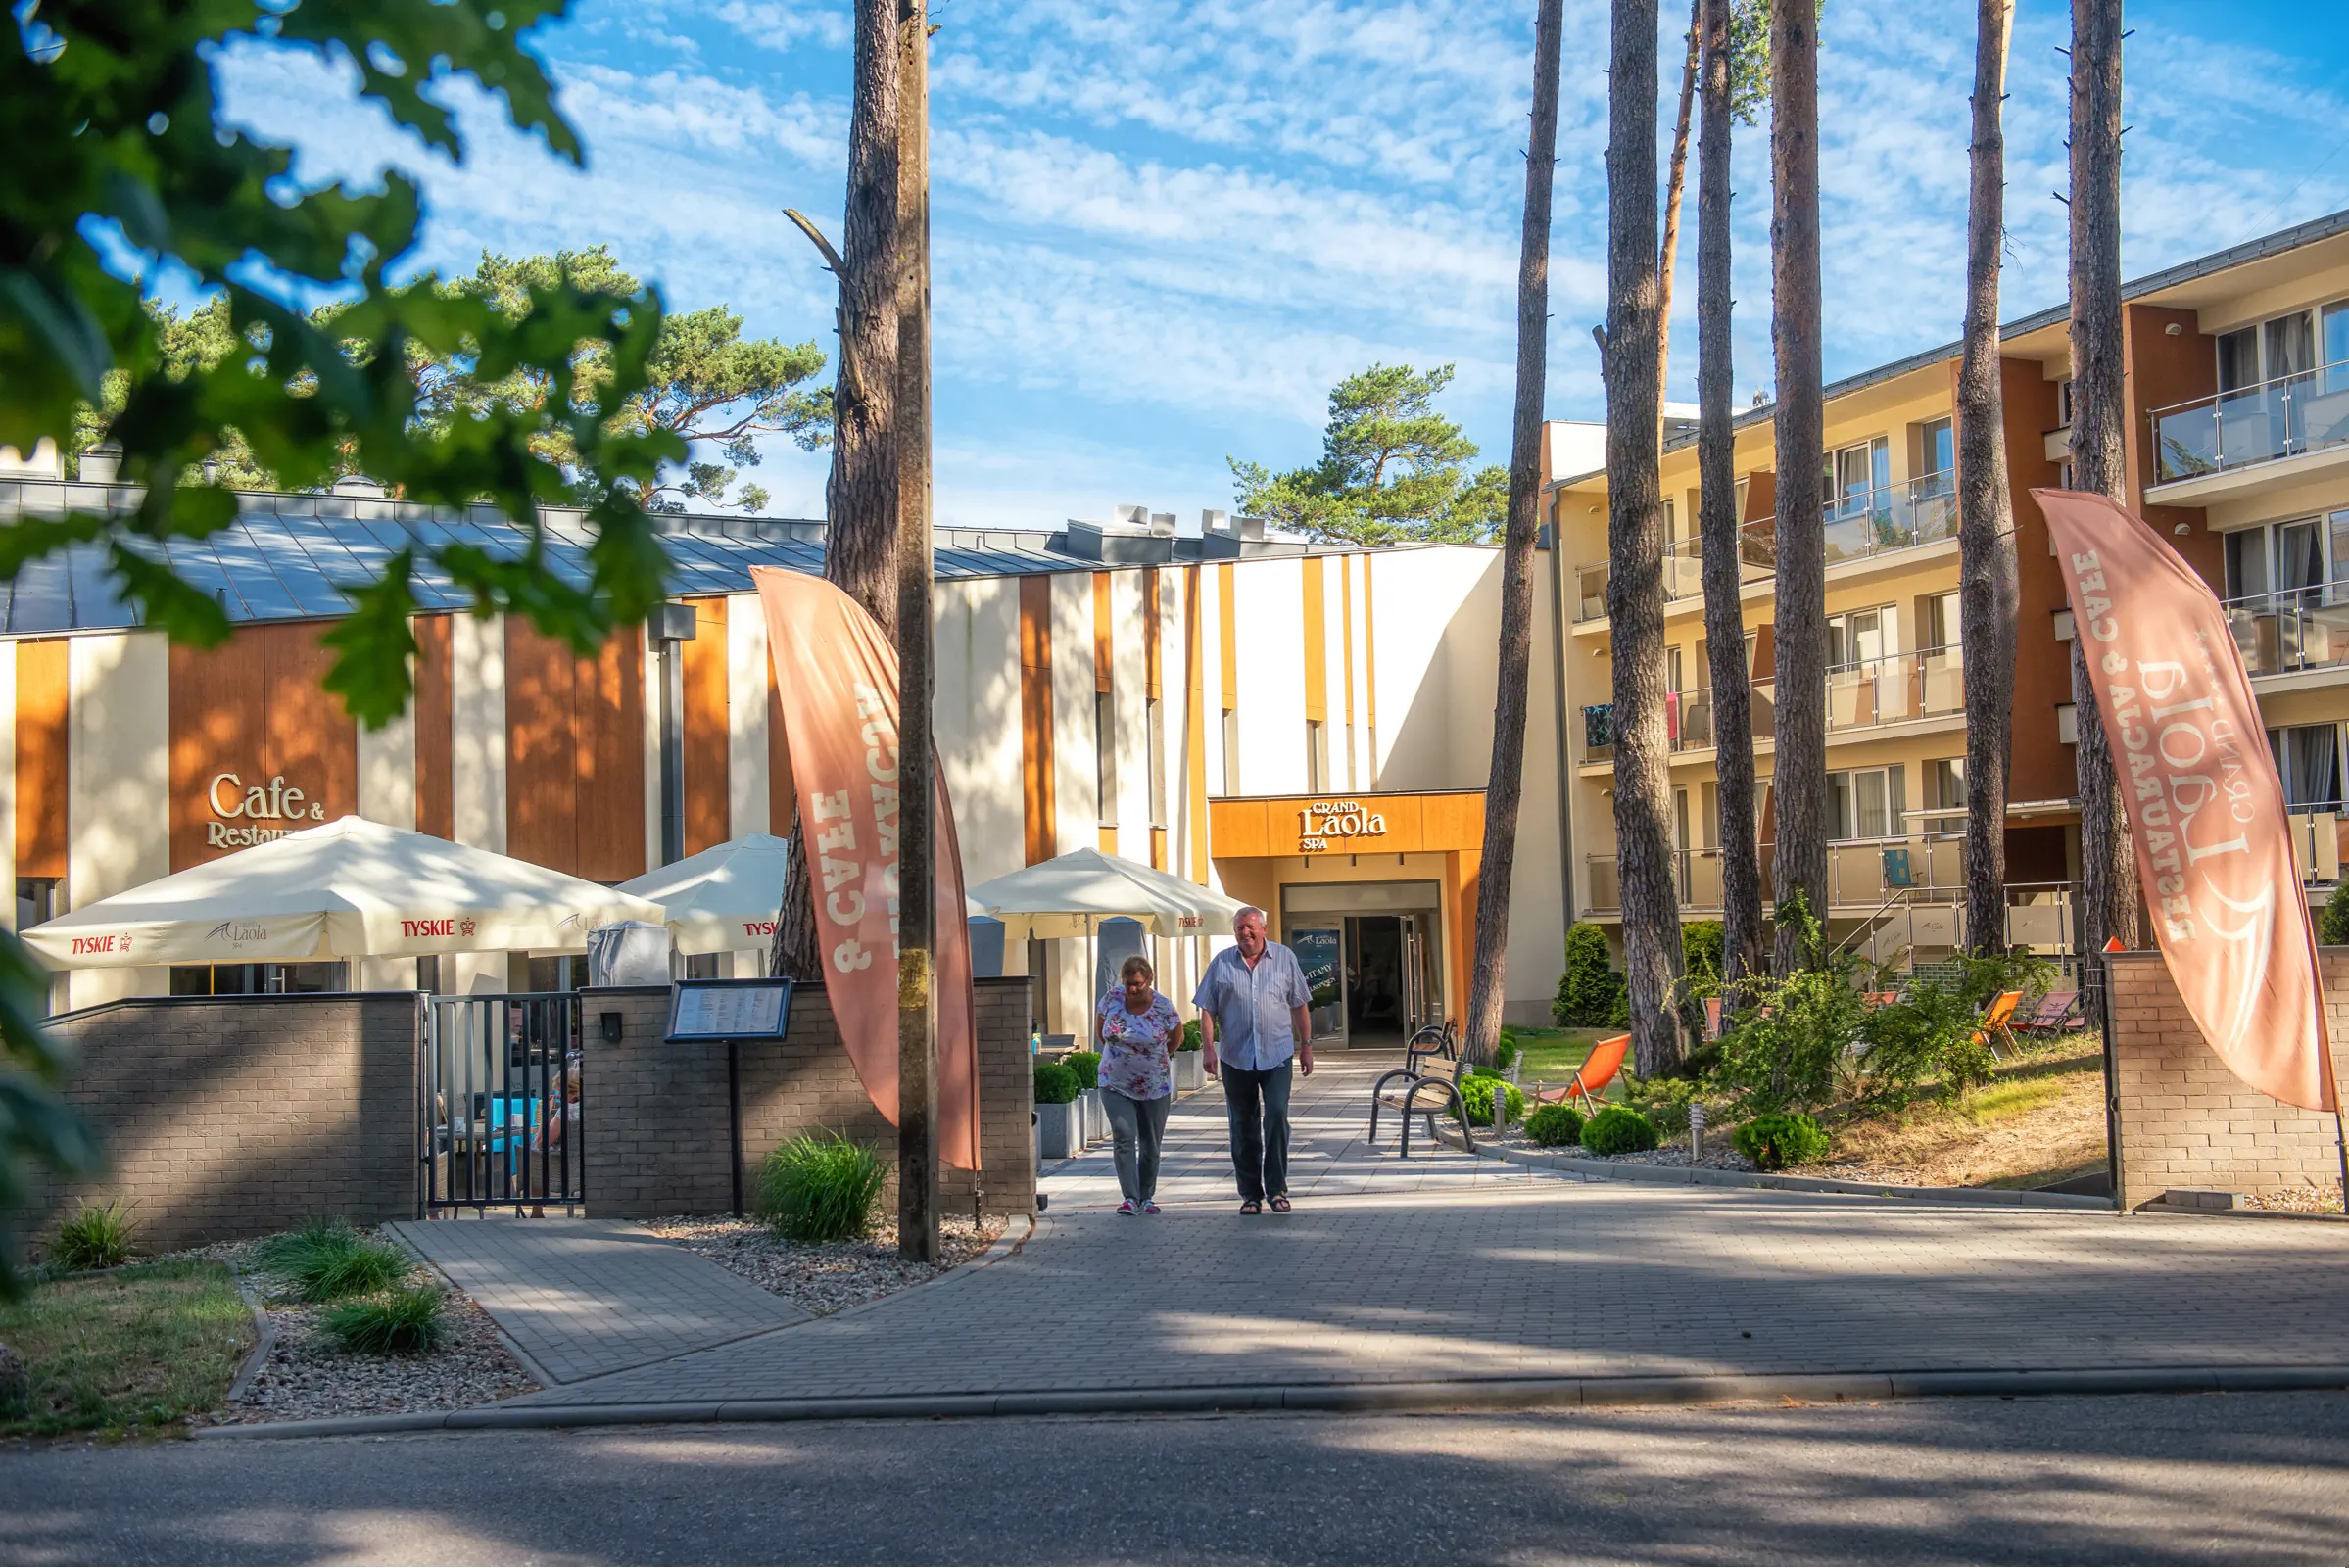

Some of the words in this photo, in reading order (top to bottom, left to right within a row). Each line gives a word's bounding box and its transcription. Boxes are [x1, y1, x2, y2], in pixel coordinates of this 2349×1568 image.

[209, 773, 306, 821] Cafe
[309, 802, 325, 821] &
[1312, 801, 1360, 814] GRAND
[1302, 807, 1388, 836] Laola
[206, 821, 298, 849] Restau
[1302, 837, 1328, 849] SPA
[233, 925, 267, 941] Laola
[400, 919, 455, 937] TYSKIE
[72, 935, 116, 954] TYSKIE
[1315, 936, 1337, 945] Laola
